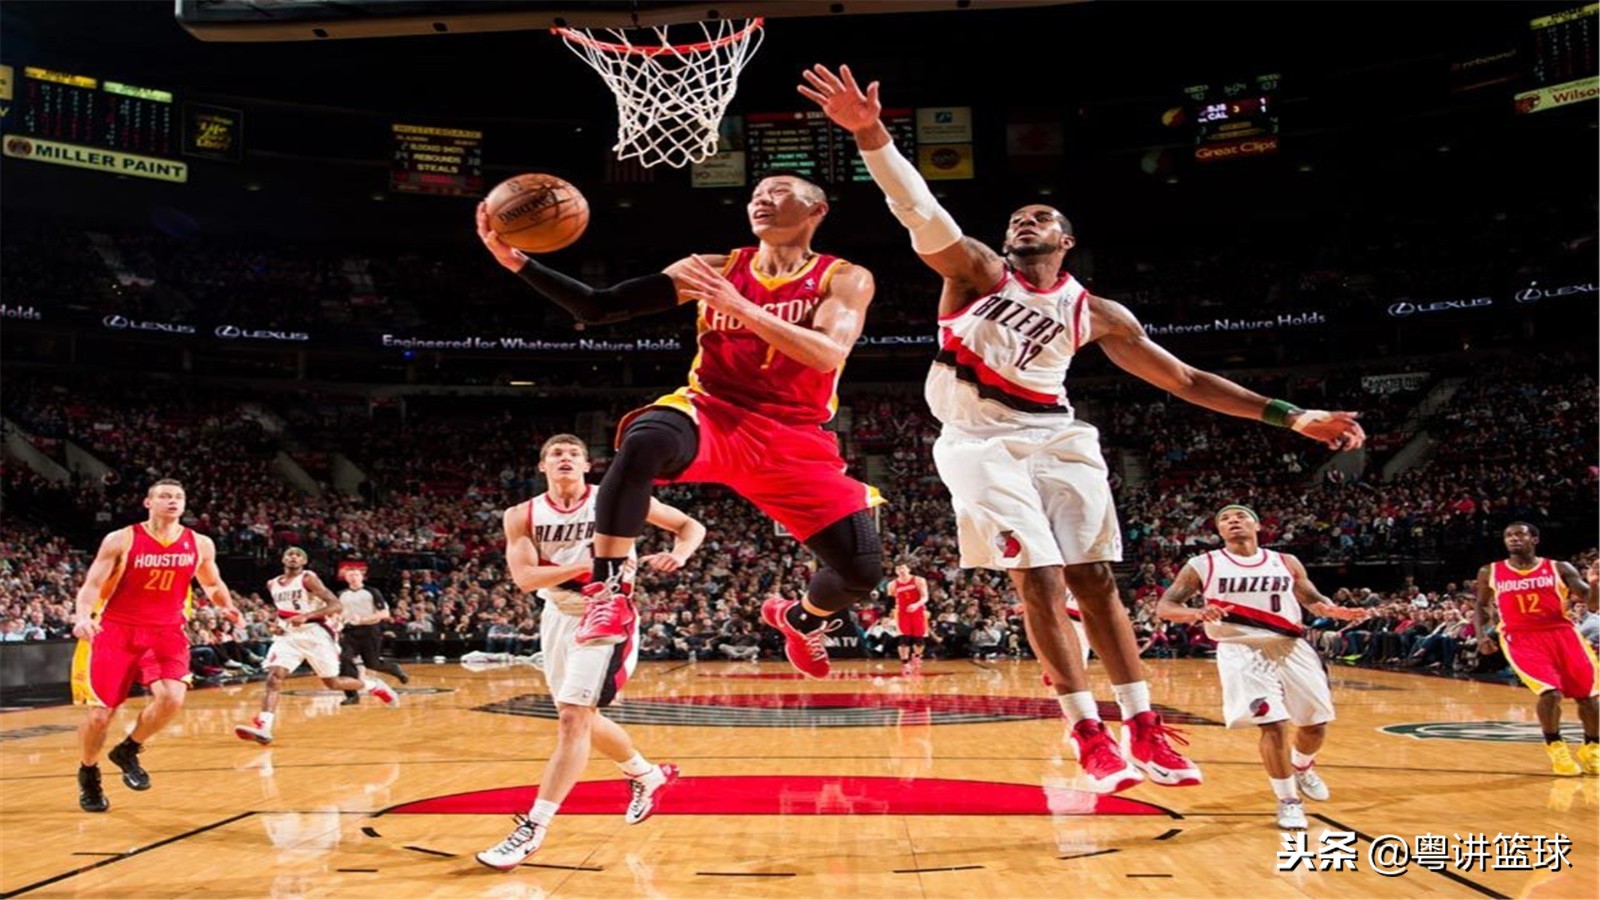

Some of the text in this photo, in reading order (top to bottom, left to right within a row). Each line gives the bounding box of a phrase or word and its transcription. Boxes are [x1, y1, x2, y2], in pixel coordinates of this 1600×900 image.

[1552, 87, 1599, 103] Wilso
[1195, 140, 1277, 158] Great Clips
[35, 144, 184, 178] MILLER PAINT
[417, 163, 459, 173] STEALS
[1417, 296, 1493, 312] LEXUS
[711, 297, 819, 331] HOSTON
[1214, 318, 1274, 332] Nature
[1277, 311, 1326, 328] Holds
[129, 318, 196, 334] LEXUS
[241, 328, 309, 341] LEXUS
[382, 334, 682, 351] Engineered for Whatever Nature Holds
[869, 334, 935, 345] LEXUS
[1014, 338, 1043, 371] 12
[534, 521, 597, 542] BLAZER
[134, 553, 195, 569] HOUSTON
[144, 569, 176, 591] 20
[1218, 576, 1291, 594] BLAZERS
[1497, 574, 1555, 592] HOUSTON
[1270, 593, 1281, 613] 0
[1516, 593, 1541, 614] 12
[841, 636, 859, 648] TV
